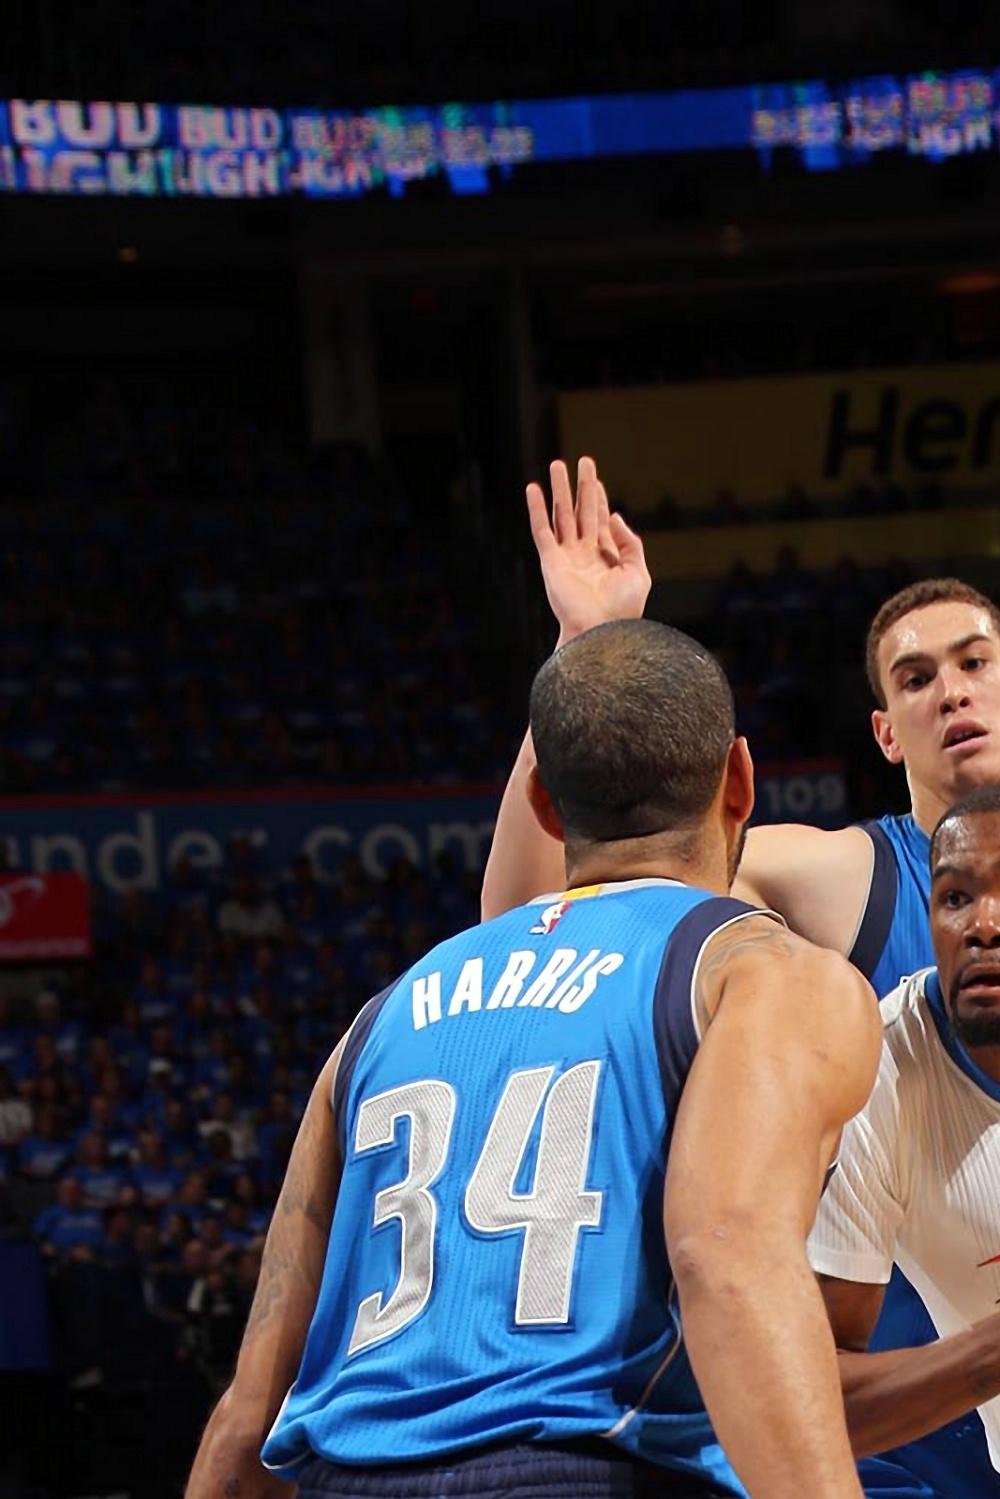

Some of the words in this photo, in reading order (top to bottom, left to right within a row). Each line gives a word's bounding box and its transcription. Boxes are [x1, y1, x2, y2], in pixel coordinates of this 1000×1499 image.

[178, 104, 283, 151] BUD
[411, 948, 624, 1031] HARRIS
[347, 1059, 603, 1357] 34
